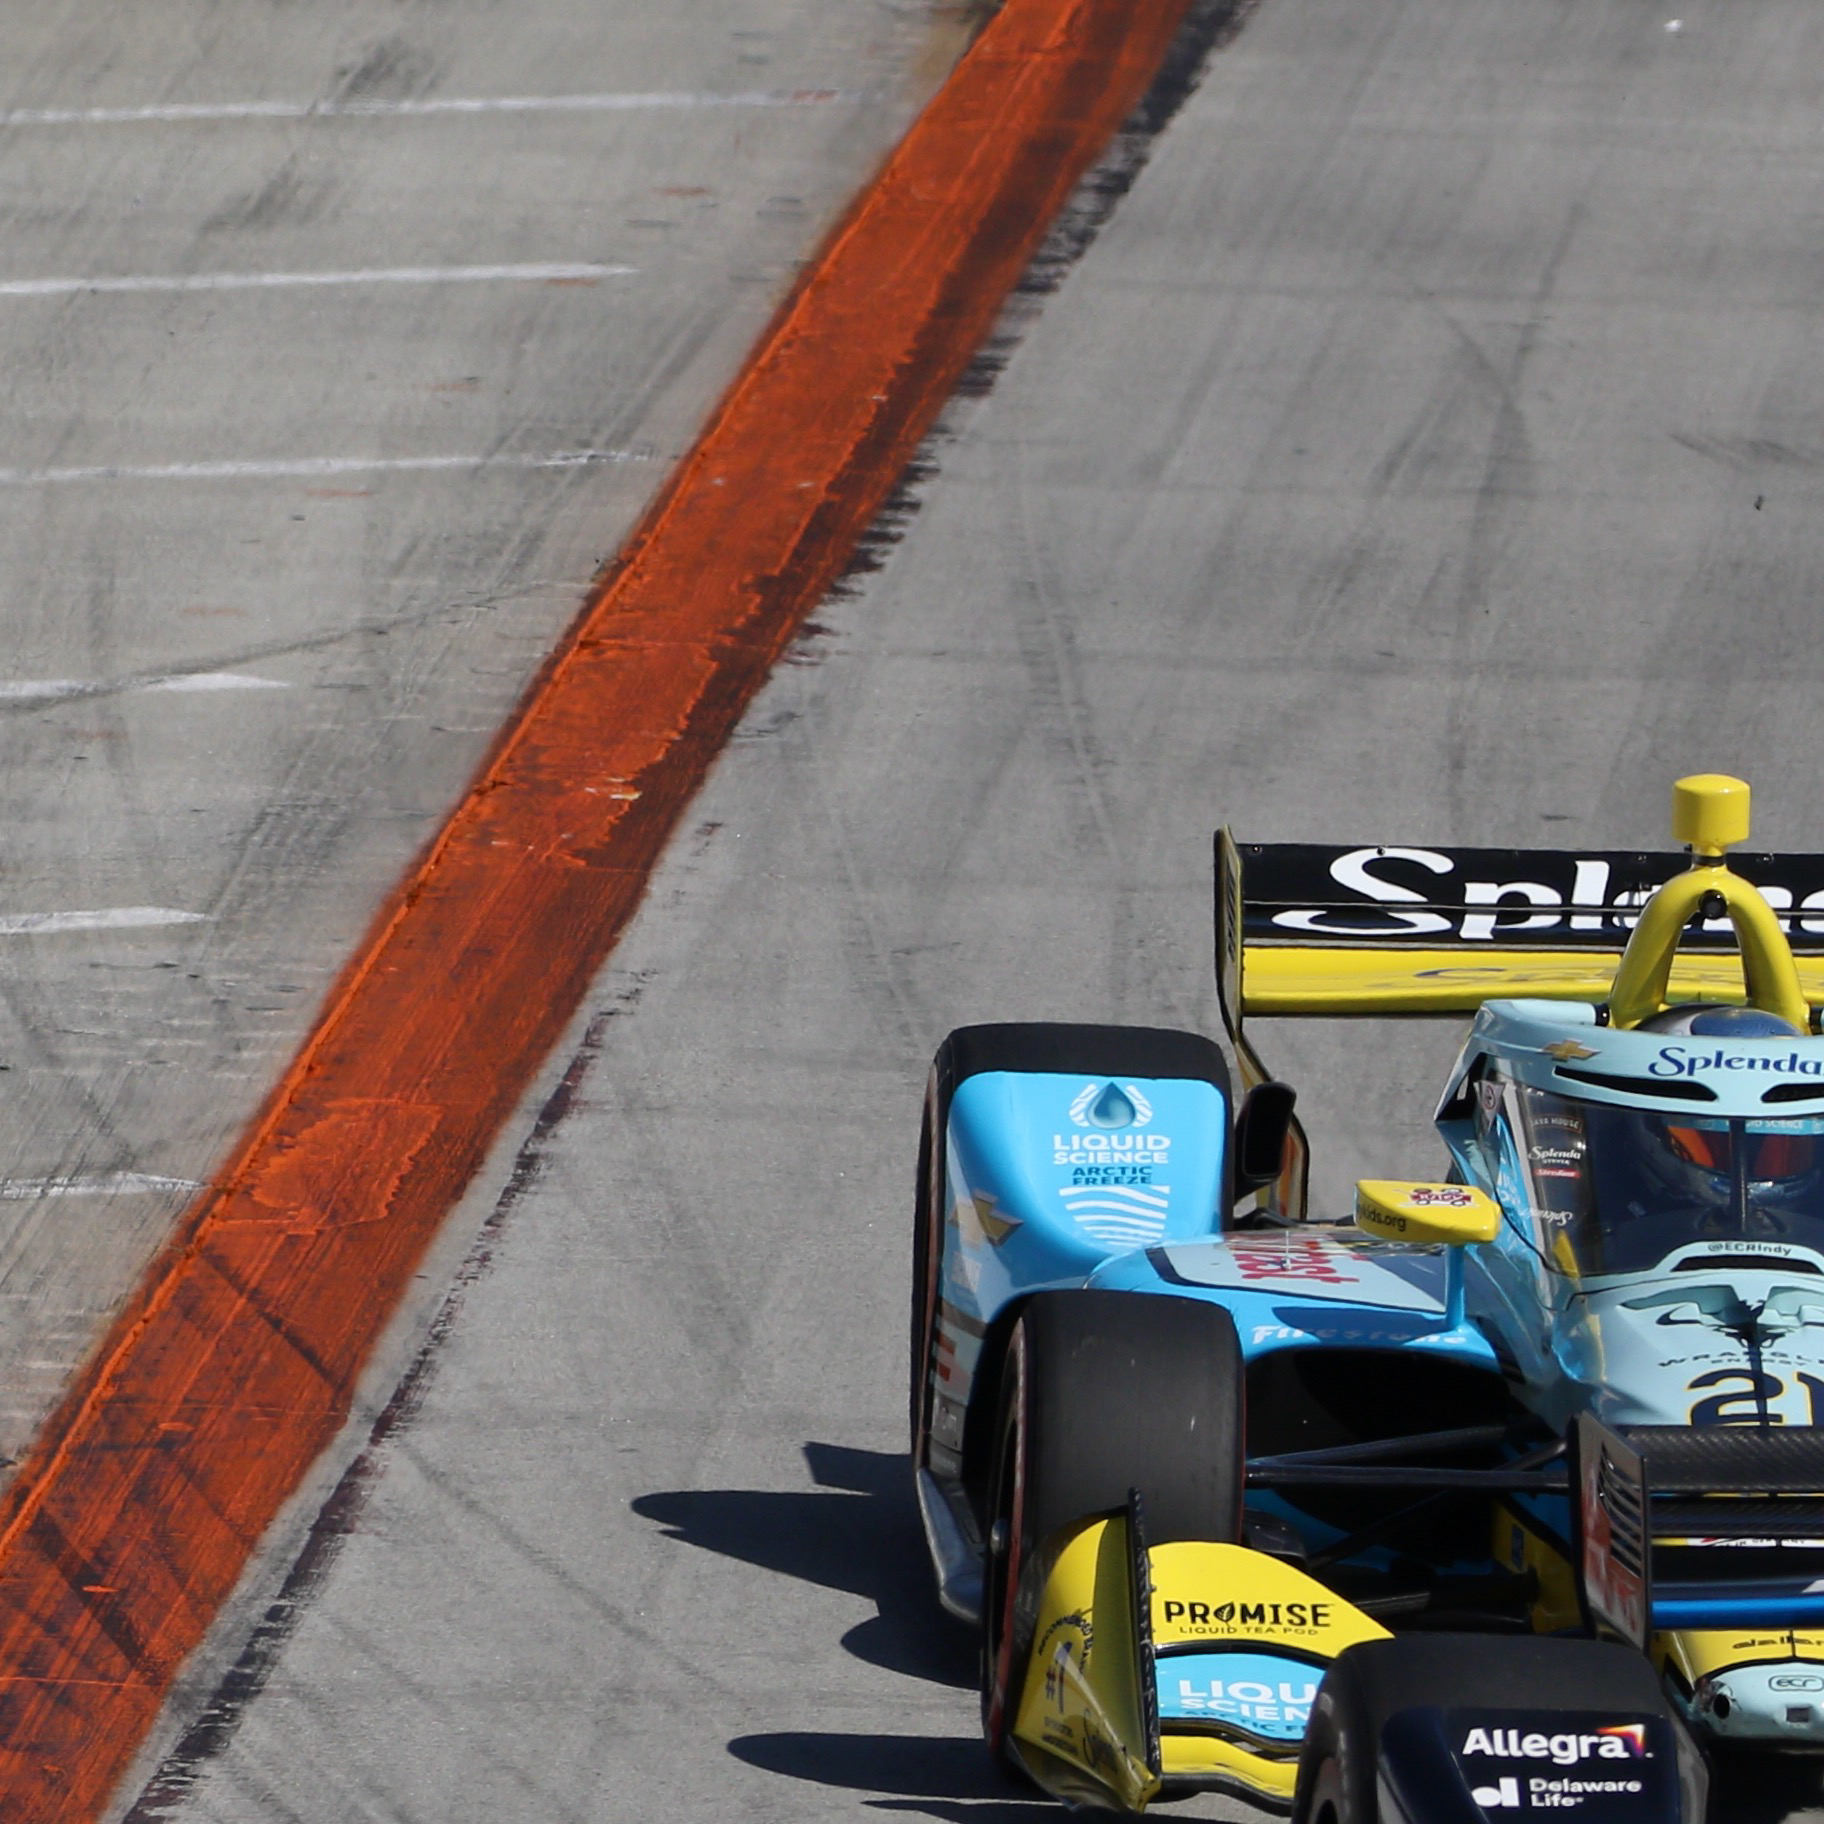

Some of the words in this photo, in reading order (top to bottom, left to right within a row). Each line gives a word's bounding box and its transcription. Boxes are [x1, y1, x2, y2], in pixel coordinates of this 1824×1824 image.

[1648, 1046, 1824, 1078] Splenda
[1053, 1134, 1172, 1152] LIQUID
[1053, 1150, 1169, 1165] SCIENCE
[1072, 1166, 1153, 1177] ARCTIC
[1072, 1176, 1153, 1186] FREEZE
[1707, 1242, 1793, 1257] @ECRIndy
[1251, 1324, 1467, 1345] Firestone
[1164, 1600, 1332, 1628] PROMISE
[1179, 1625, 1238, 1635] LIQUID
[1244, 1626, 1276, 1634] TEA
[1282, 1626, 1319, 1636] POD
[1774, 1676, 1819, 1690] ecr
[1178, 1679, 1321, 1705] LIQU
[1180, 1698, 1311, 1721] SCIEN
[1461, 1727, 1631, 1766] Allegra
[1528, 1778, 1642, 1794] Delaware
[1529, 1793, 1578, 1808] Life
